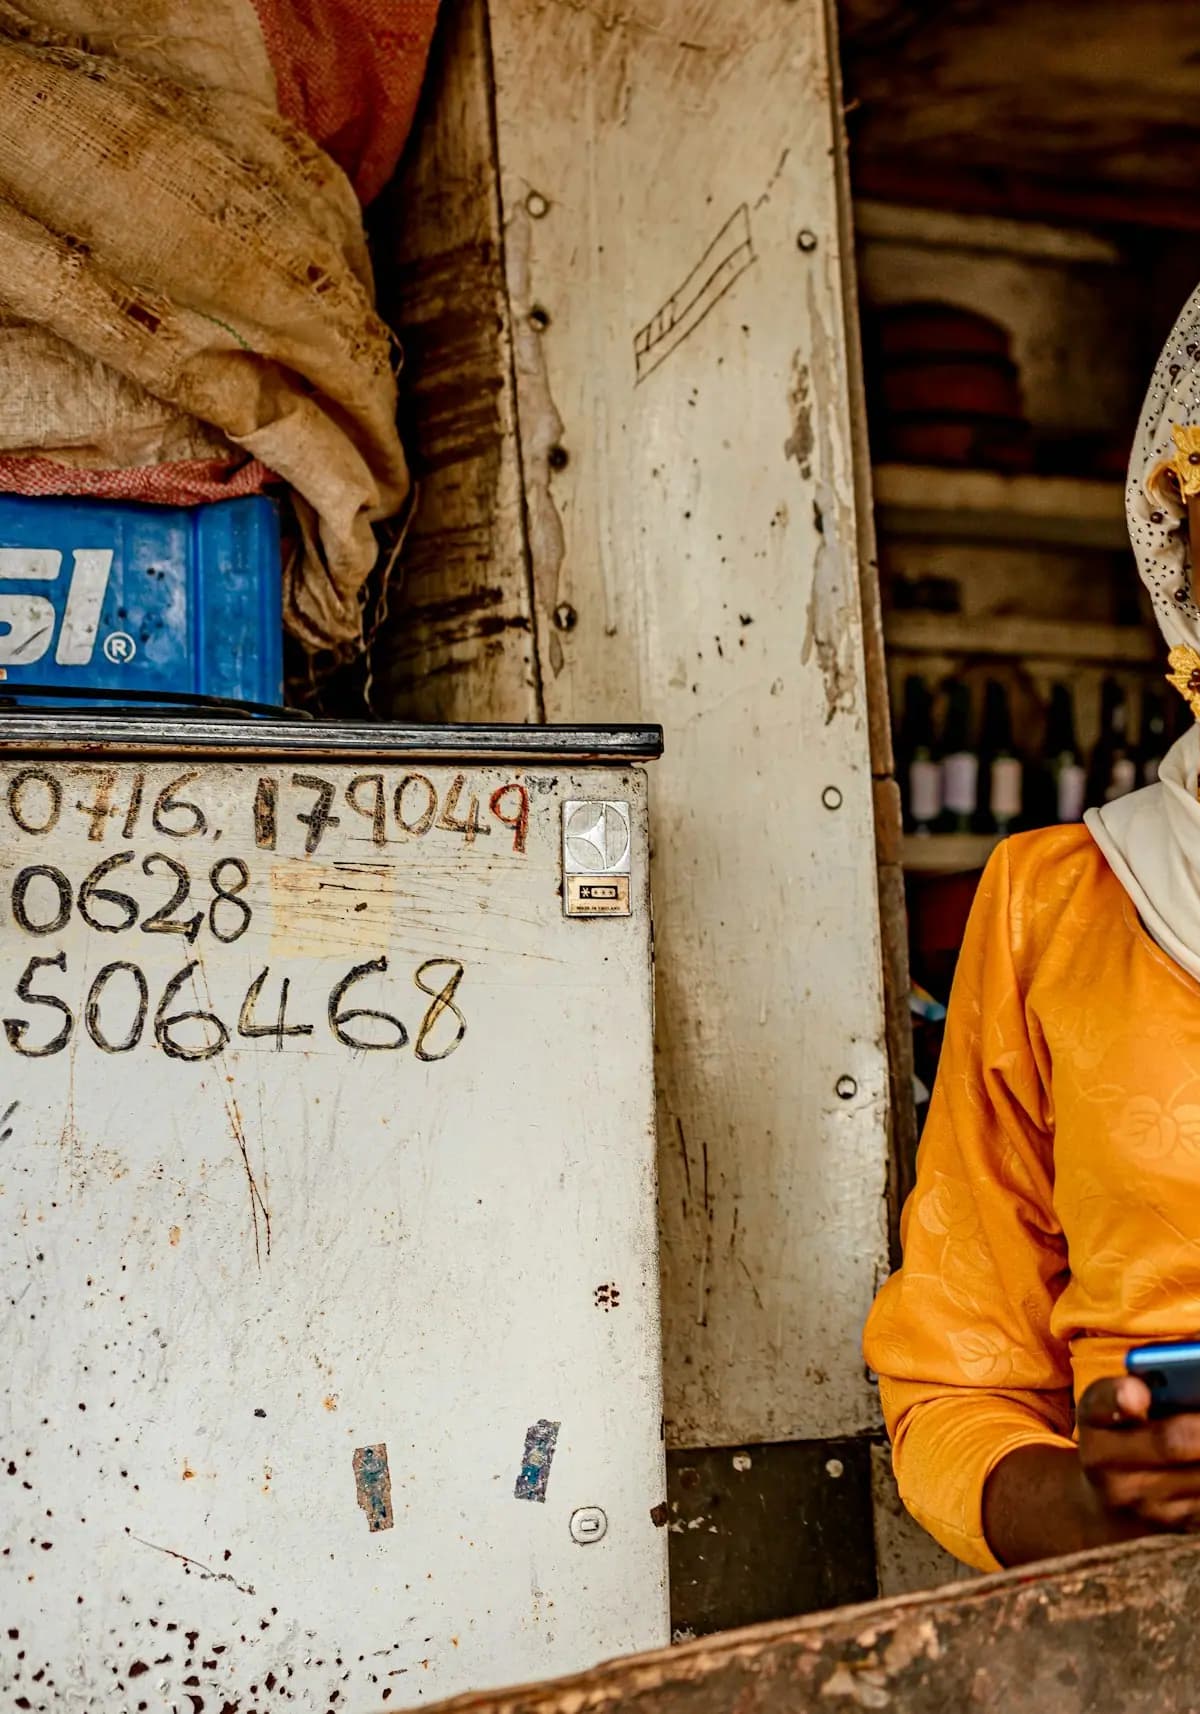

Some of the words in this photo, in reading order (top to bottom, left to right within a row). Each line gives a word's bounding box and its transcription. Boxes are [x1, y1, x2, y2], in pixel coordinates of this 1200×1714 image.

[253, 773, 529, 854] 179049
[12, 850, 252, 943] 0628
[2, 950, 467, 1062] 506468
